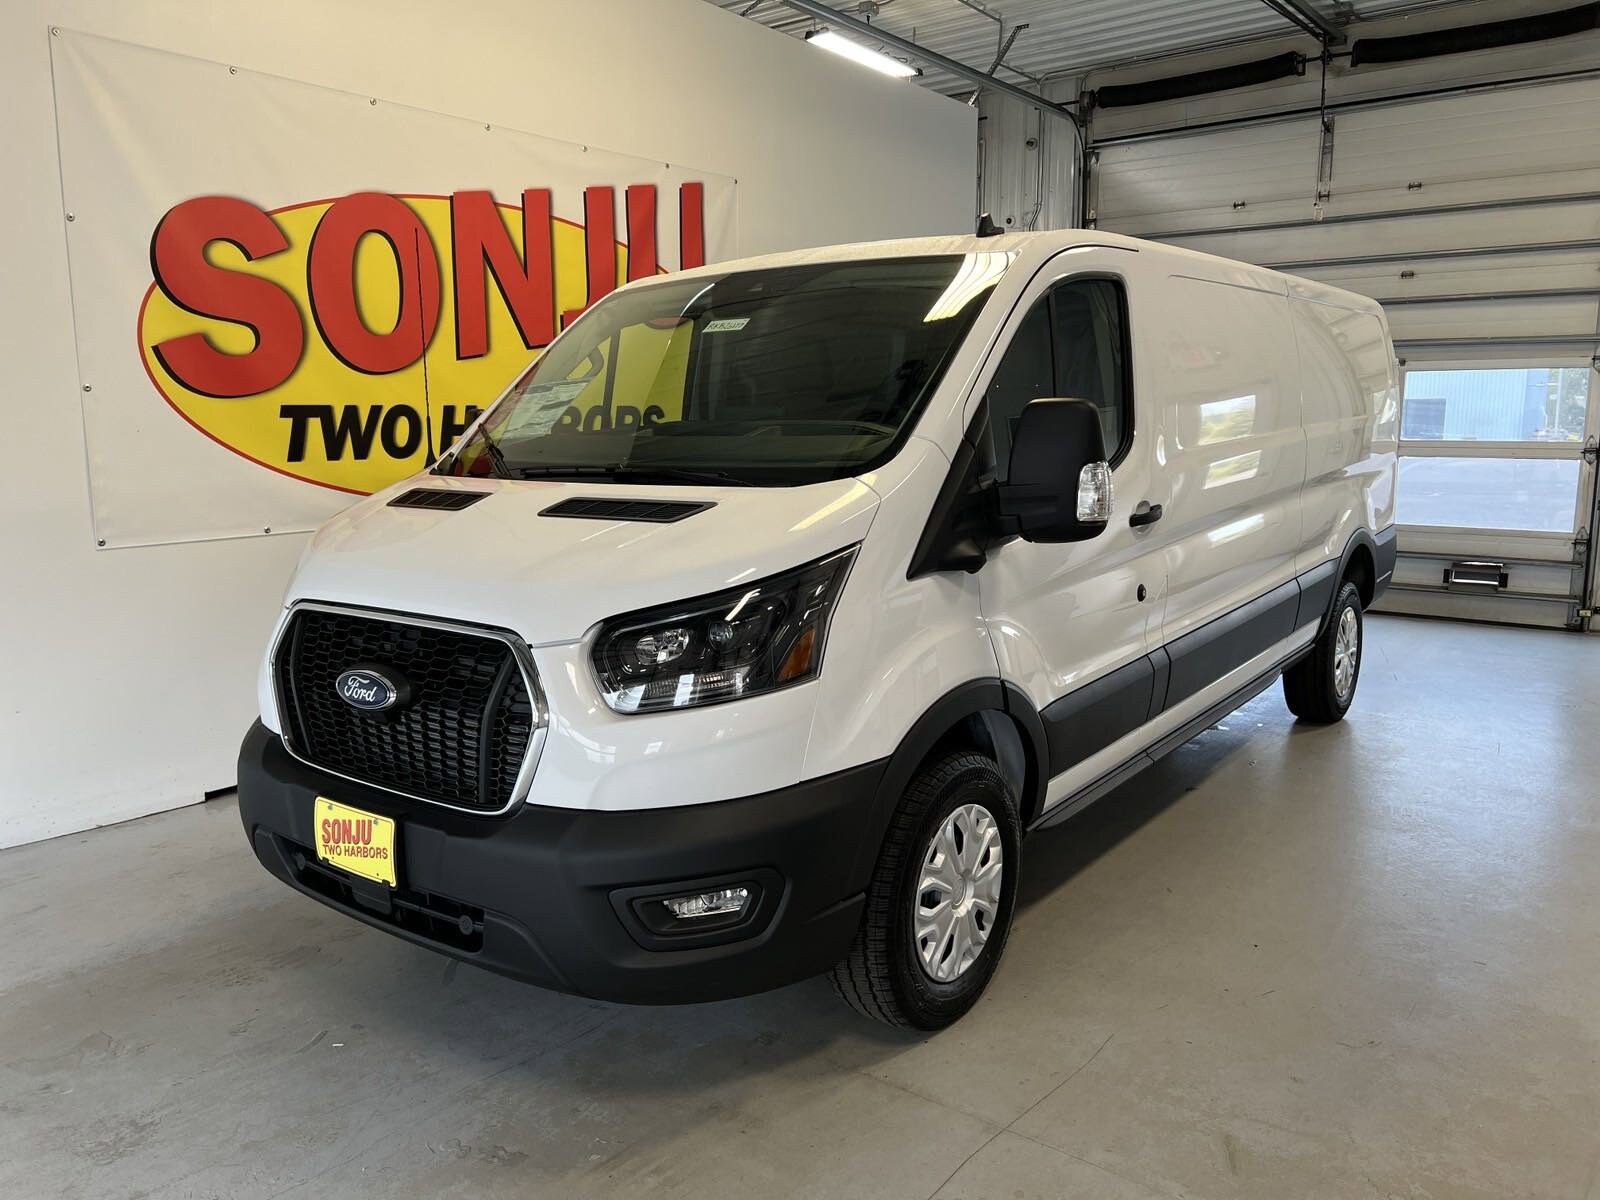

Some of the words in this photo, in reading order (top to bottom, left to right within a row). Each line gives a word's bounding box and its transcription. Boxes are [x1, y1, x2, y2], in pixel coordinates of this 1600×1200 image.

[150, 182, 706, 399] SONJU
[279, 404, 423, 463] TWO
[344, 675, 377, 702] Ford
[321, 818, 372, 845] SONJU
[322, 844, 342, 857] TWO
[344, 845, 389, 860] HARBORS
